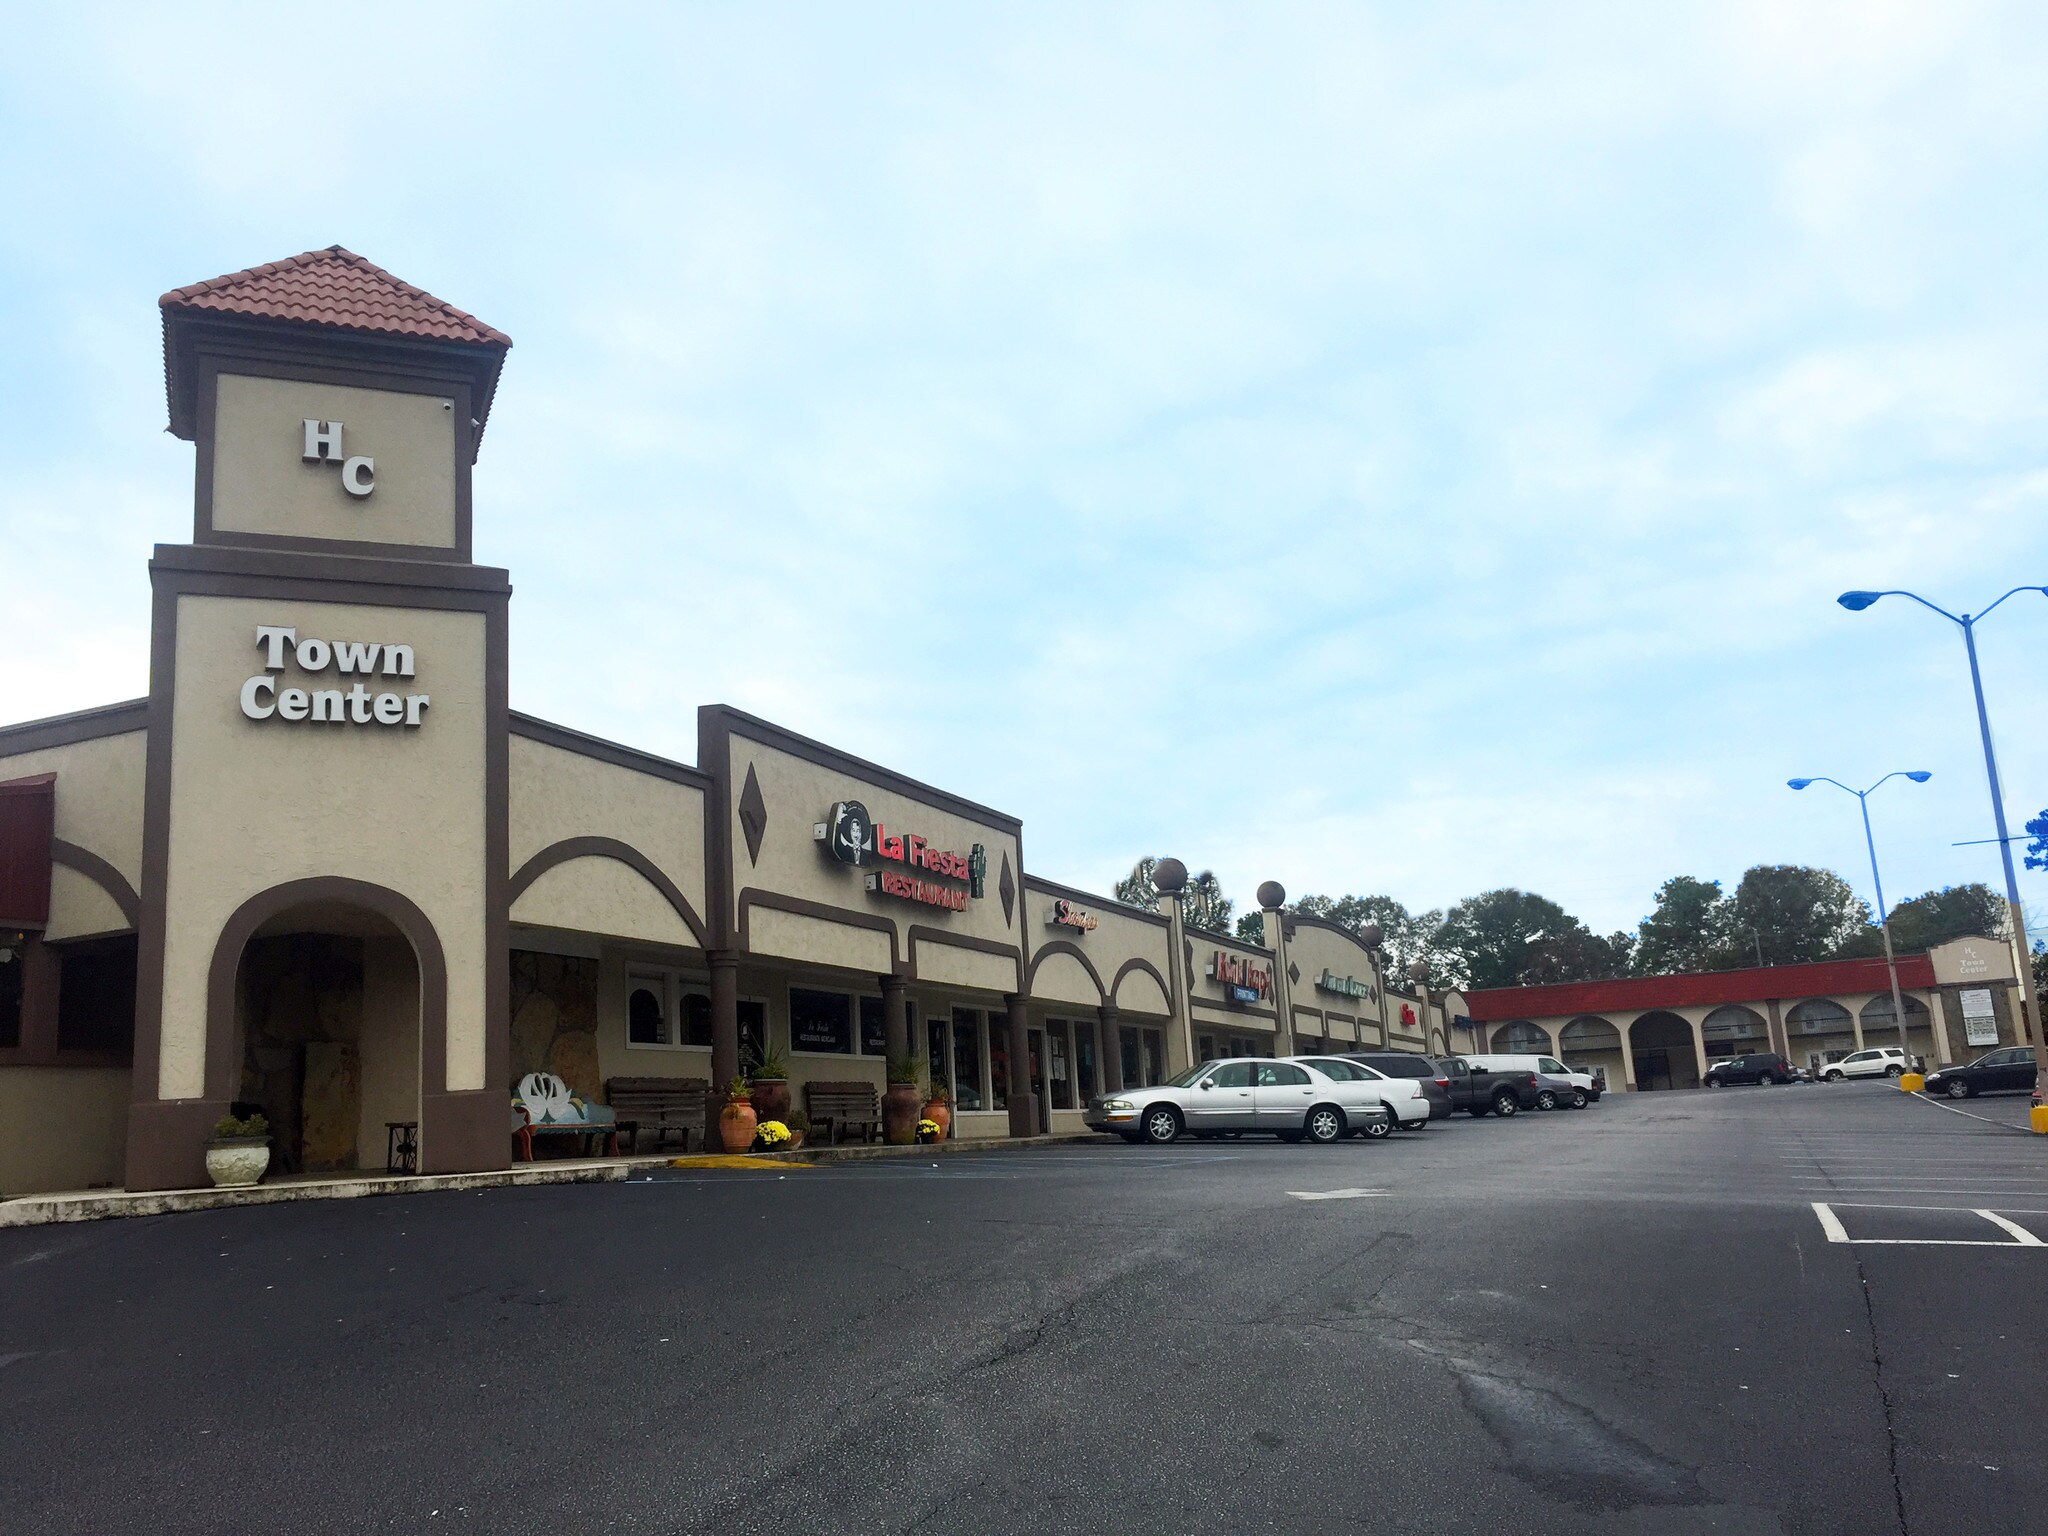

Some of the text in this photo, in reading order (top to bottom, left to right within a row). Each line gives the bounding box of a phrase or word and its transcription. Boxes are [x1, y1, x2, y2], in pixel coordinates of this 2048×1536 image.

[302, 418, 344, 462] H
[342, 455, 375, 498] C
[256, 624, 415, 679] Town
[240, 675, 430, 726] Center
[874, 824, 969, 880] La Fiesta
[880, 870, 967, 912] RESTAURANT
[1960, 959, 1985, 967] Town
[1960, 966, 1988, 974] Center
